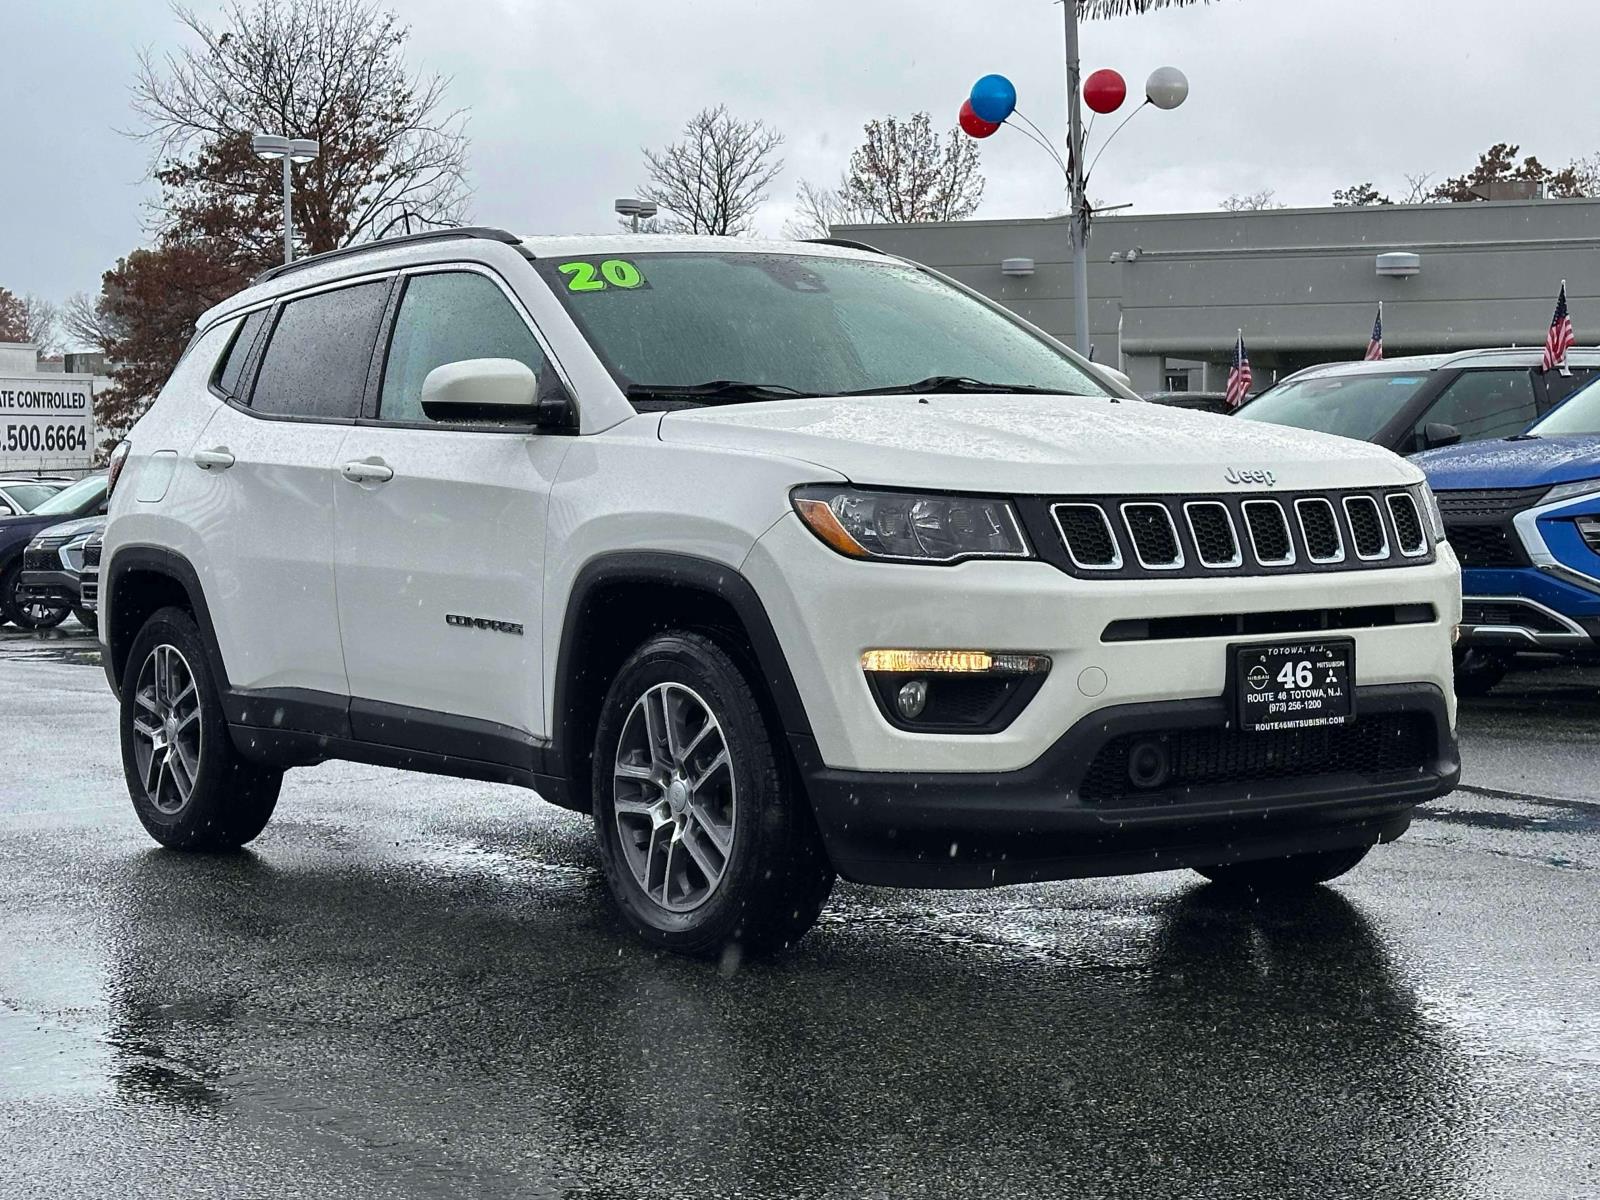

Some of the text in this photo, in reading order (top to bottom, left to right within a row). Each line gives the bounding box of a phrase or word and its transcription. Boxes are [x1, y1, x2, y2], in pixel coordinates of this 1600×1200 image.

[559, 260, 644, 290] 20
[0, 391, 86, 409] TE CONTROLLED
[0, 424, 87, 452] .500.6664
[1224, 466, 1276, 487] Jeep
[445, 614, 524, 635] COMPASS
[1268, 645, 1327, 656] TOTOWA, N.J.
[1316, 660, 1345, 669] MITSUBISHI
[1276, 660, 1313, 689] 46
[1247, 687, 1343, 703] ROUTE 46 TOTOWA, N.J.
[1269, 700, 1322, 714] (973) 256-1200
[1255, 716, 1345, 732] ROUTE46MITSUBISHI.COM
